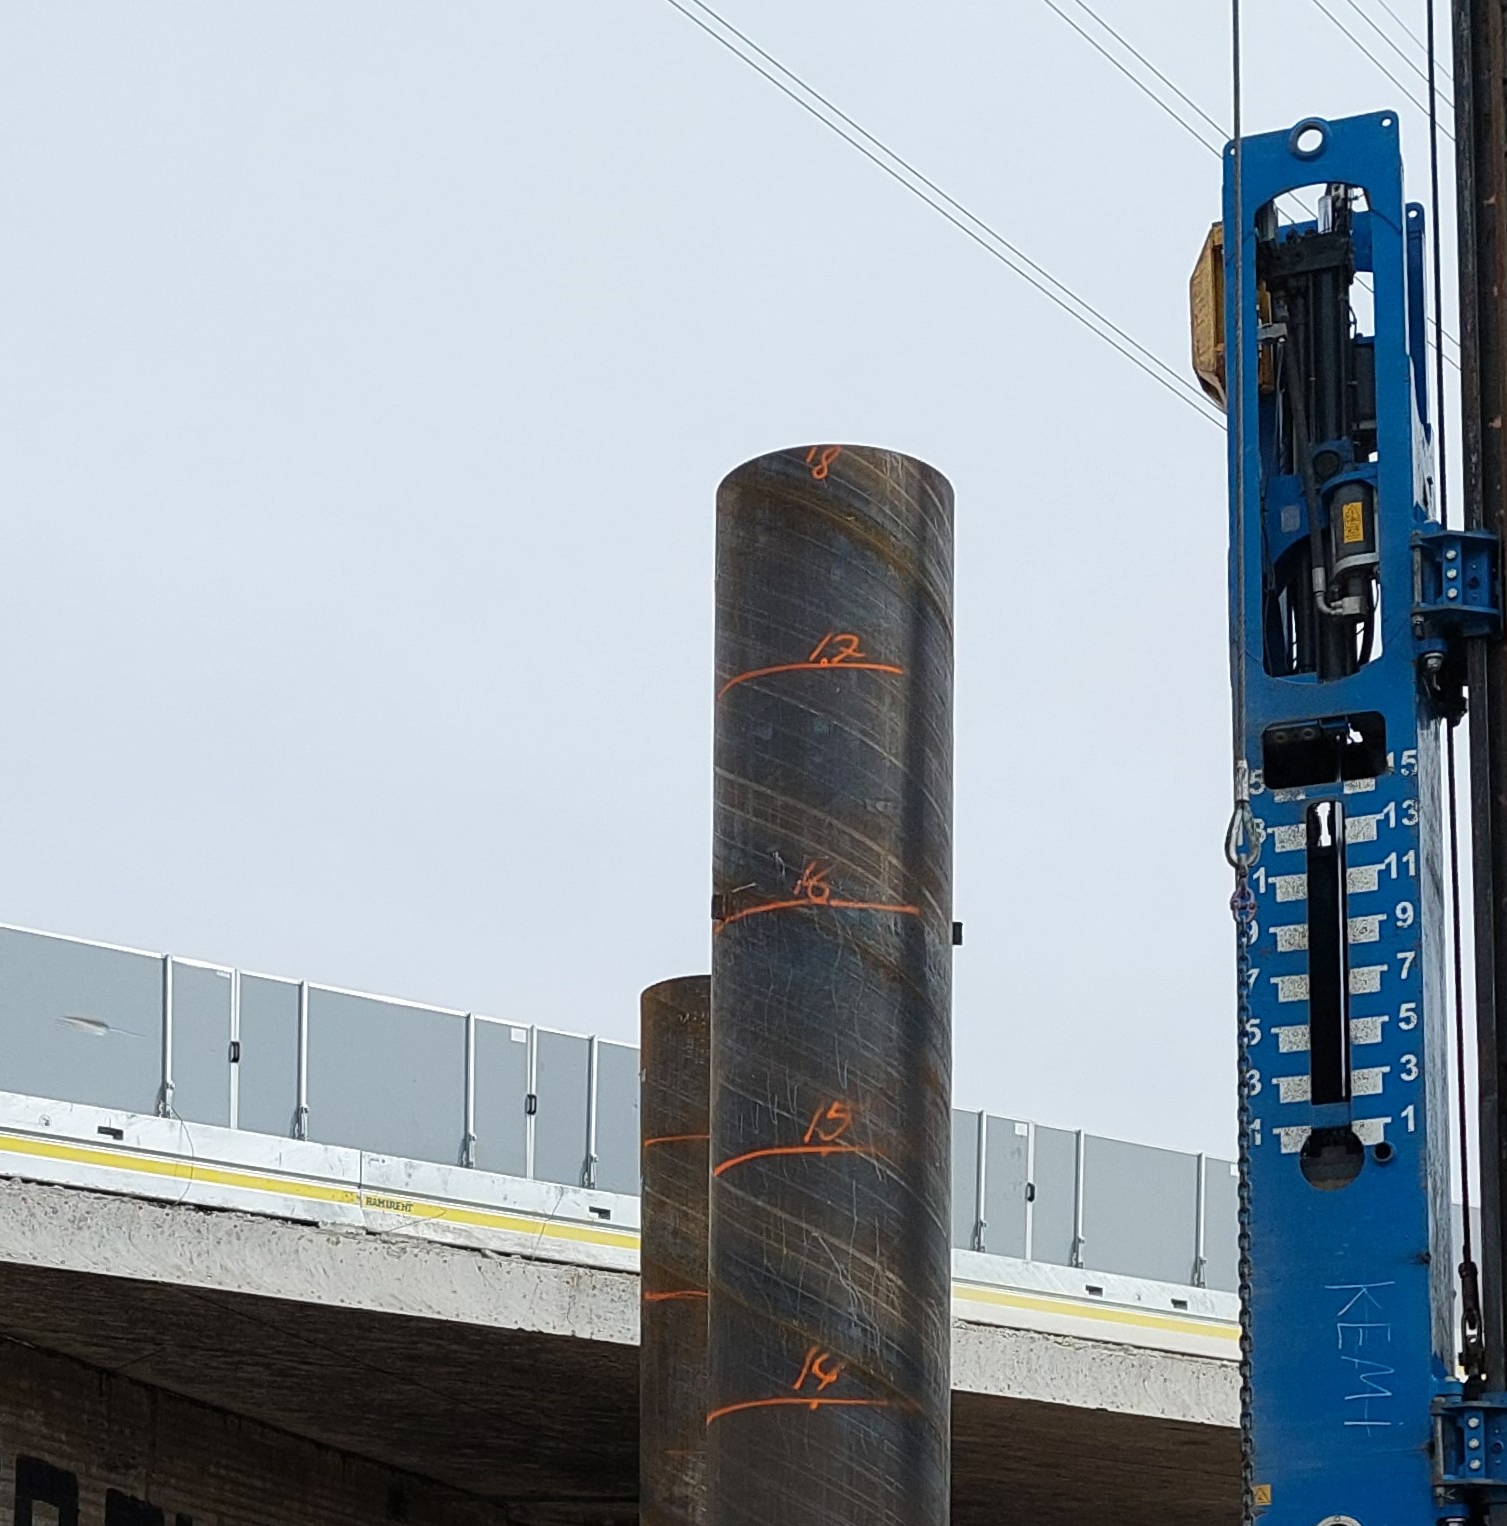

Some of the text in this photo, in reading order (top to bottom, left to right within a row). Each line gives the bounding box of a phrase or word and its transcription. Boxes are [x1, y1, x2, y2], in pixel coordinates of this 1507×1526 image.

[1383, 800, 1419, 829] 13
[1383, 850, 1416, 880] 11
[1396, 901, 1414, 929] 9
[1397, 950, 1415, 980] 7
[1398, 1002, 1418, 1031] 5
[1400, 1054, 1419, 1082] 3
[803, 1102, 854, 1142] 15
[1400, 1104, 1416, 1134] 1
[793, 1347, 845, 1390] 14
